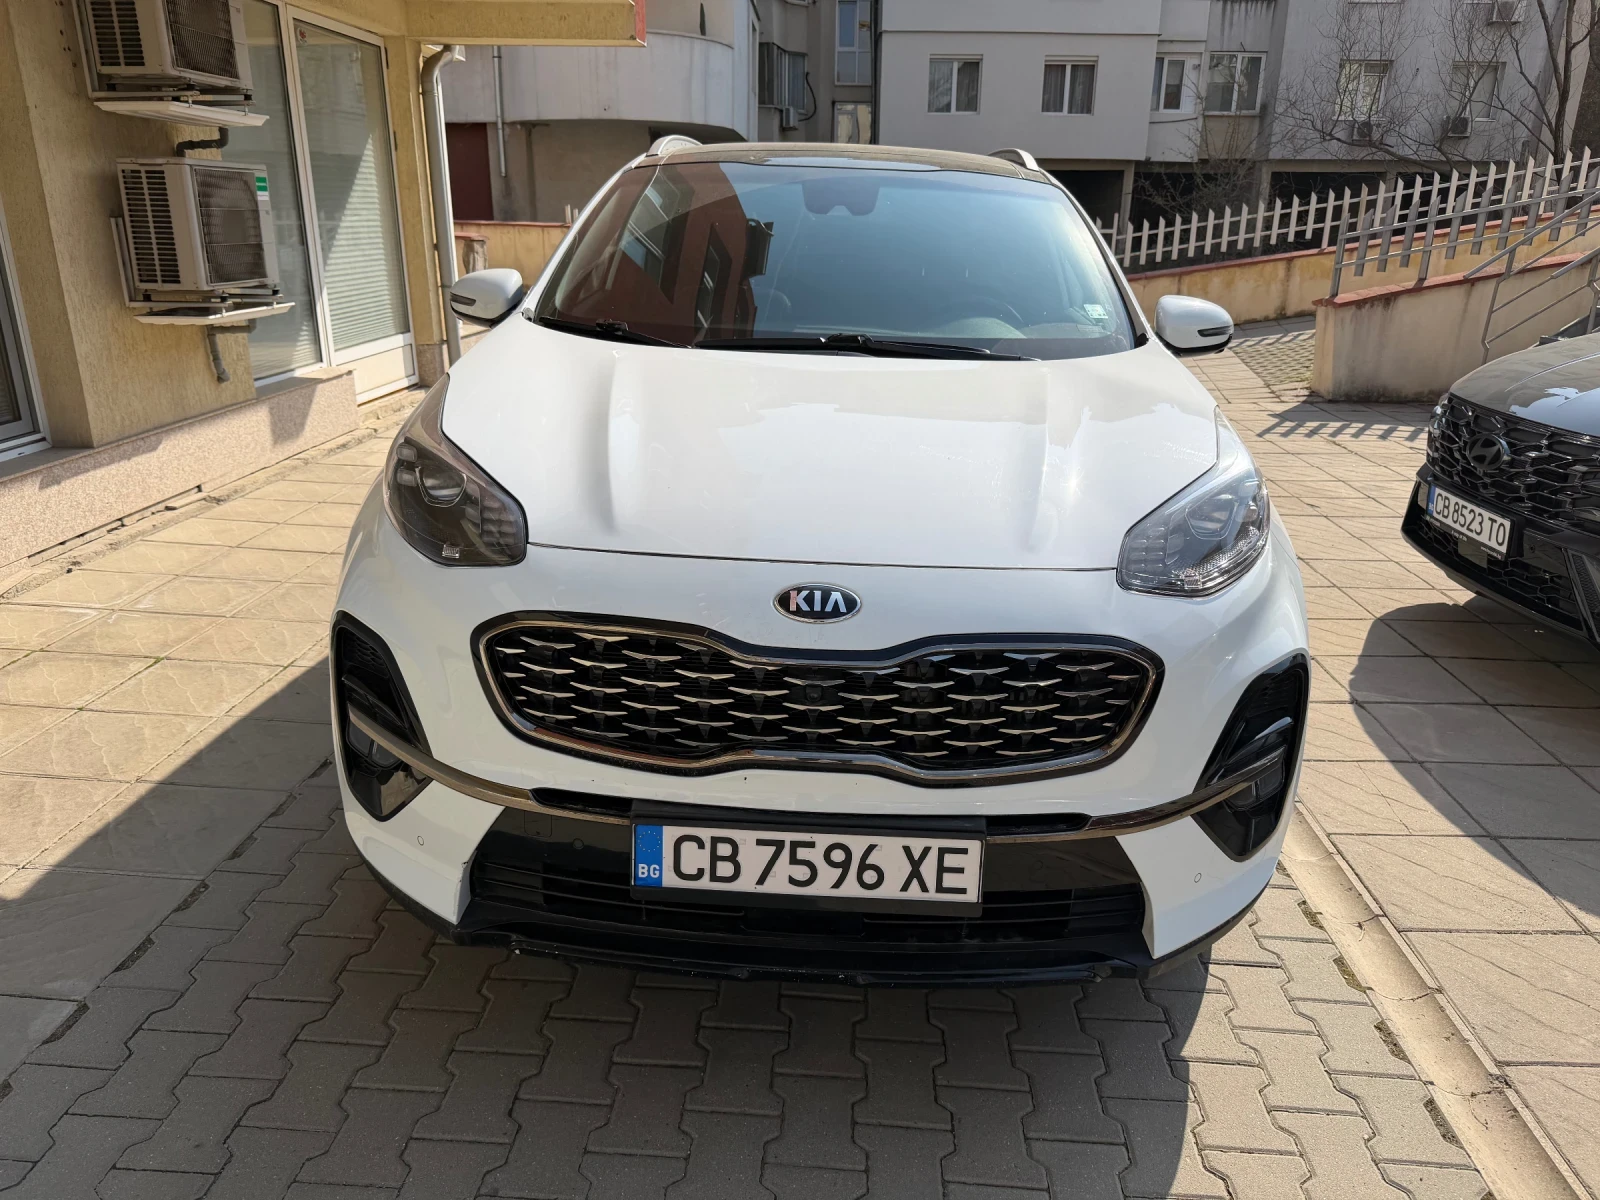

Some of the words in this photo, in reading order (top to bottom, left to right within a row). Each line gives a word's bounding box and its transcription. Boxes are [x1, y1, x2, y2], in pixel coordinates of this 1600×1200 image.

[1434, 492, 1450, 519] CB
[1451, 501, 1484, 536] 8523
[1487, 516, 1506, 547] TO
[789, 590, 847, 612] KIA
[638, 863, 661, 879] BG
[673, 834, 741, 883] CB
[755, 838, 885, 891] 7596
[899, 845, 969, 894] XE
